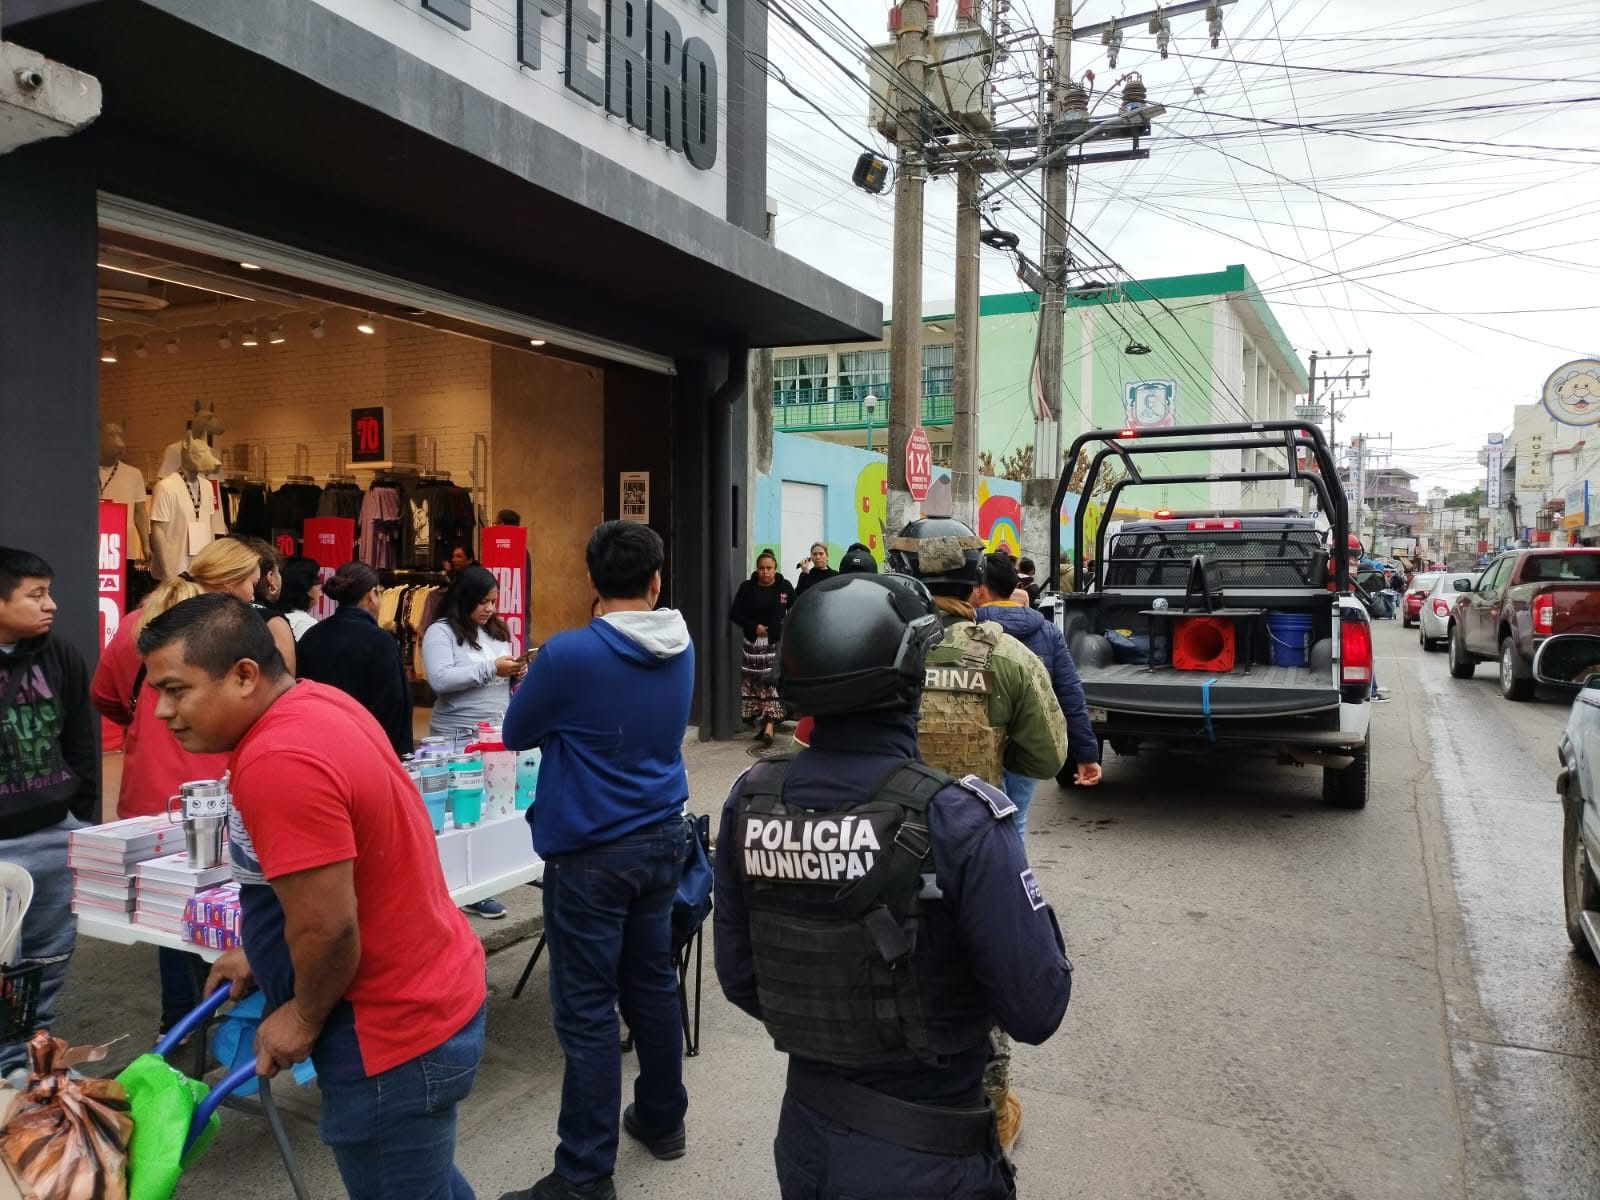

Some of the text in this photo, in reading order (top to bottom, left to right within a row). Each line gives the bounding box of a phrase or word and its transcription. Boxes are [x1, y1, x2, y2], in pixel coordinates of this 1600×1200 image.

[356, 419, 379, 449] 70
[1532, 435, 1542, 475] HOTEL
[924, 669, 987, 691] RINA
[0, 769, 71, 794] ALIFORNIA
[745, 815, 881, 851] POLICÍA
